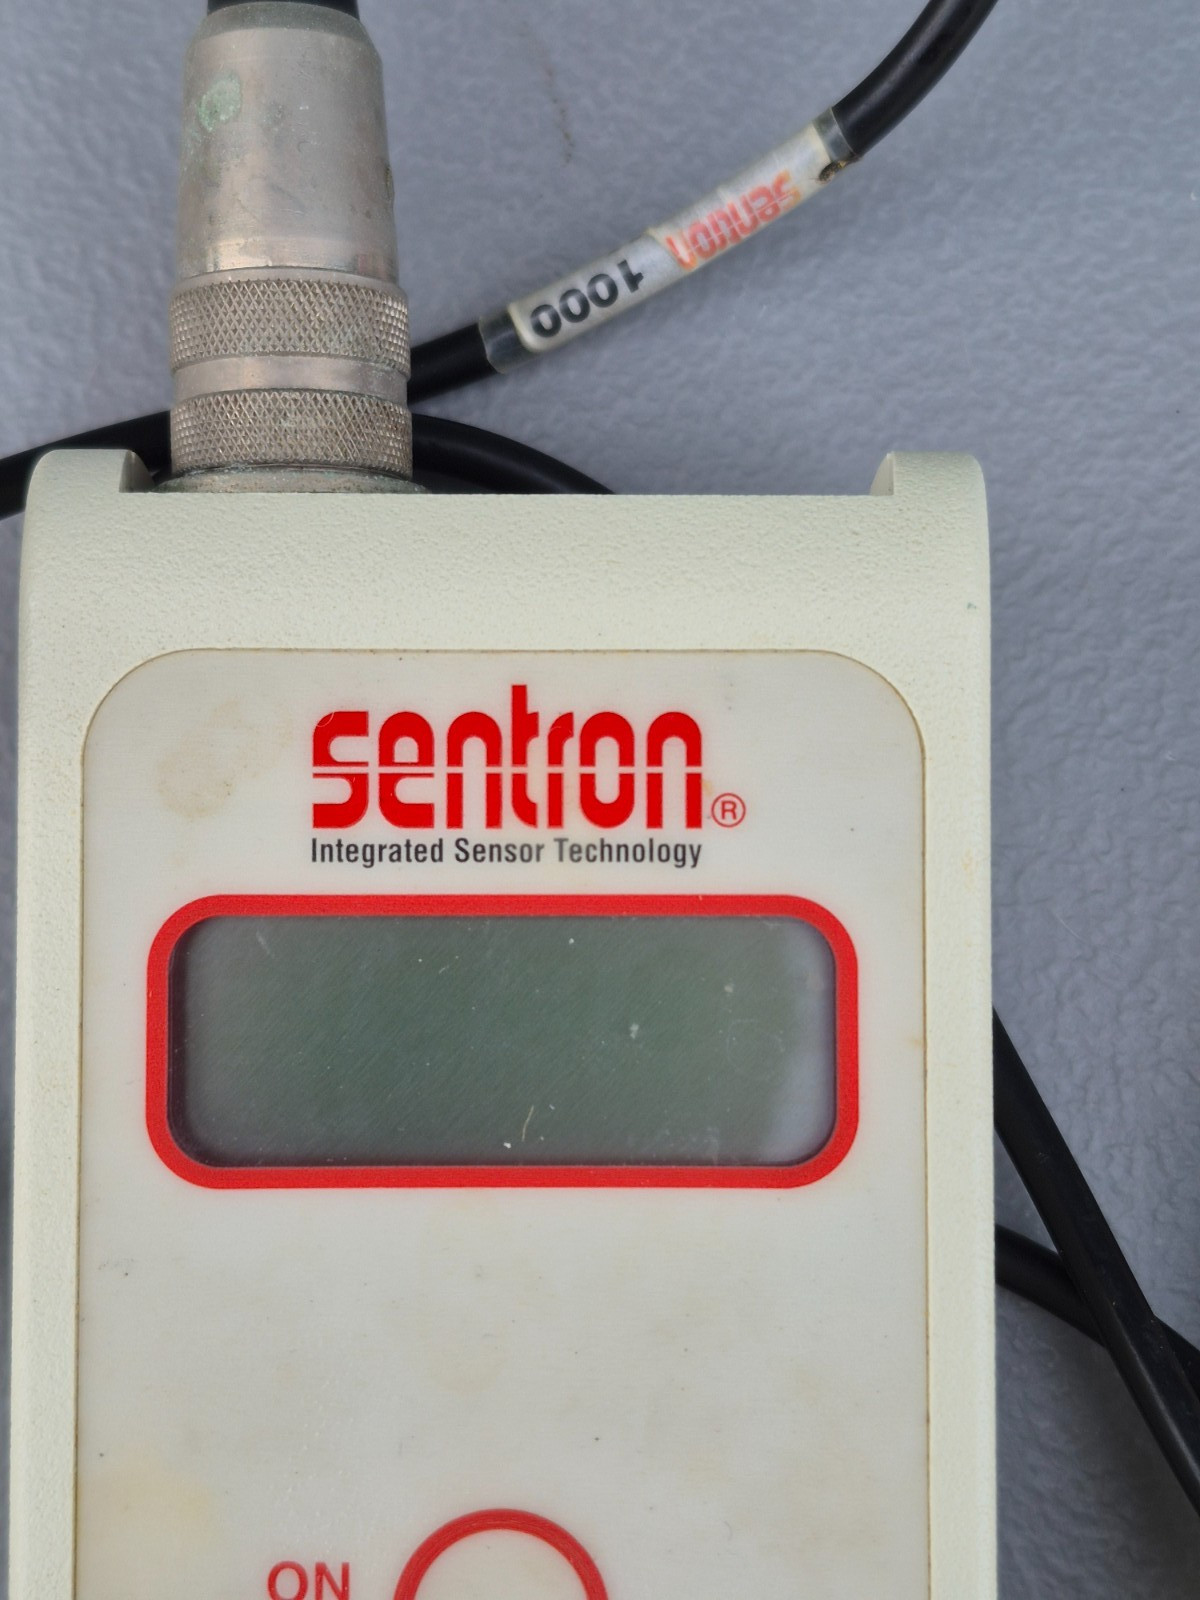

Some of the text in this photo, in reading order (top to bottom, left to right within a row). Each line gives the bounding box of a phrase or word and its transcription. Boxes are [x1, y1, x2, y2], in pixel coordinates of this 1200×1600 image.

[530, 170, 803, 338] sentron 1000
[312, 684, 703, 829] sentron
[311, 837, 703, 869] Integrated Sensor Technology
[267, 1560, 351, 1600] ON
